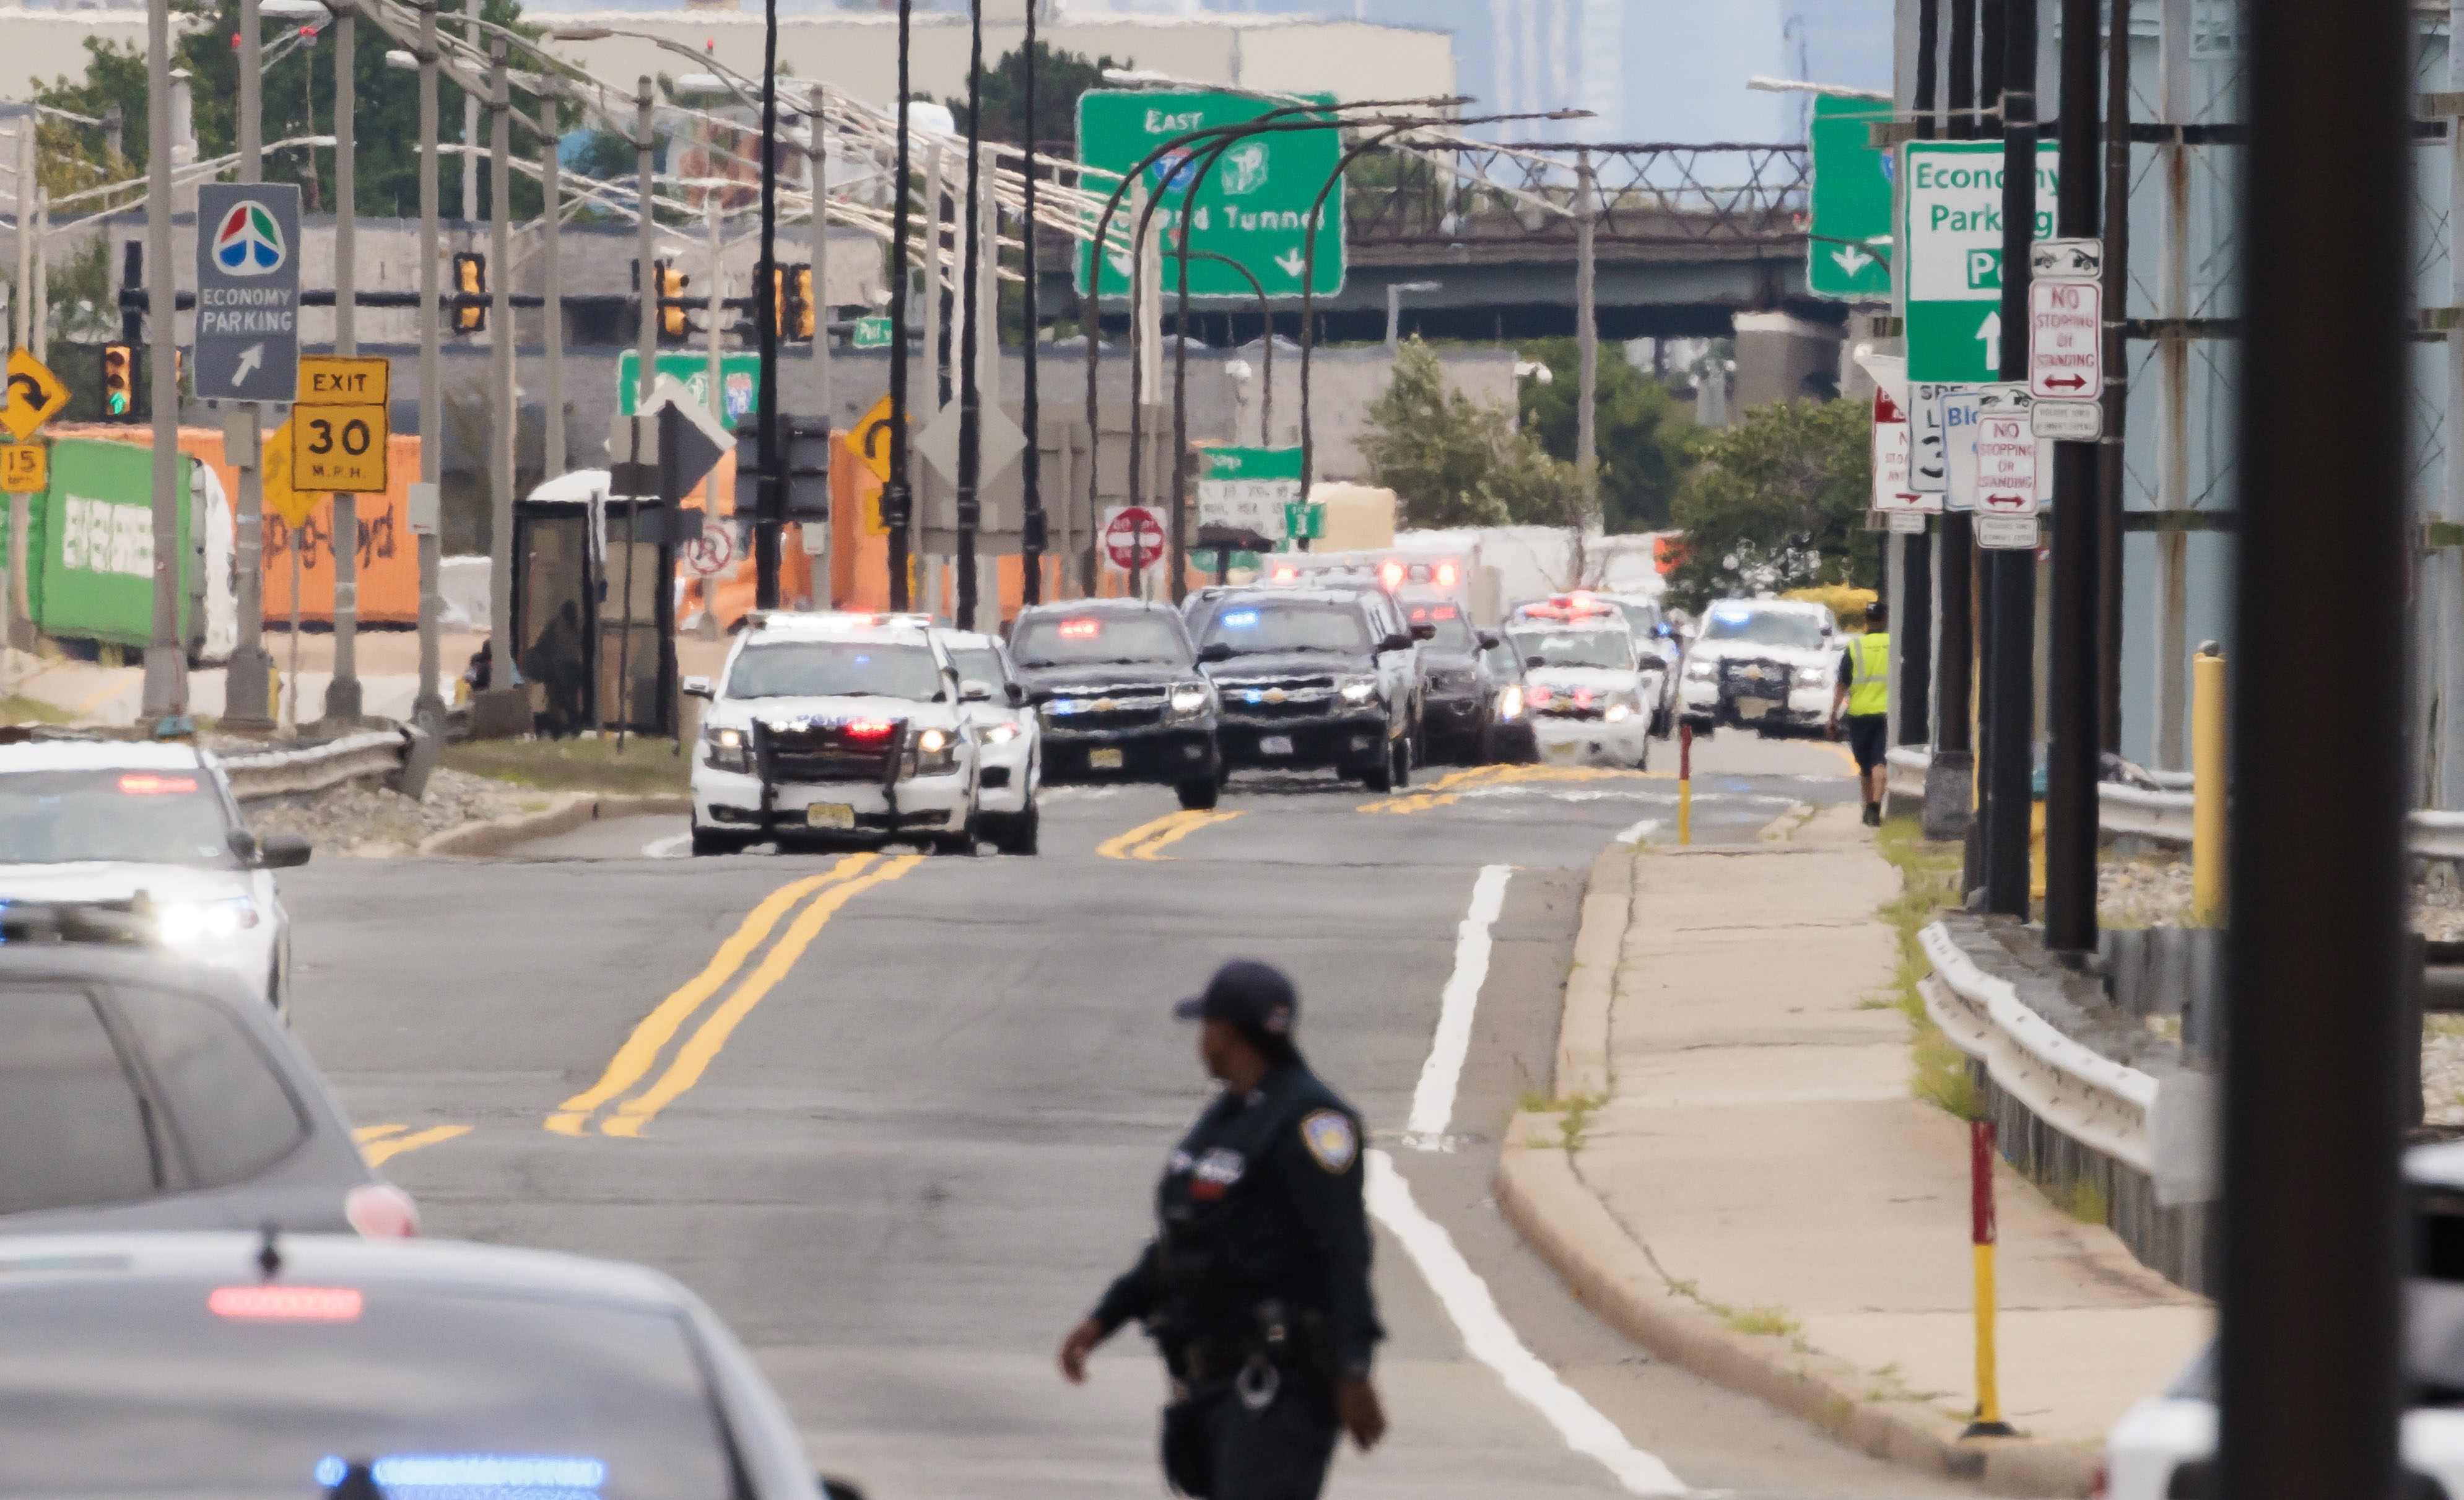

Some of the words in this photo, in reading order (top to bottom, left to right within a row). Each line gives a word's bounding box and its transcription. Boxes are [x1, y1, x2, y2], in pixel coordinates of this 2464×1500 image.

[1145, 108, 1203, 134] EAST
[1931, 203, 2053, 240] Parkg
[203, 288, 292, 306] ECONOMY
[2051, 287, 2079, 309] NO
[202, 311, 293, 333] PARKING
[313, 374, 367, 391] EXIT
[309, 419, 370, 455] 30
[1993, 422, 2019, 438] NO
[9, 450, 35, 473] 15
